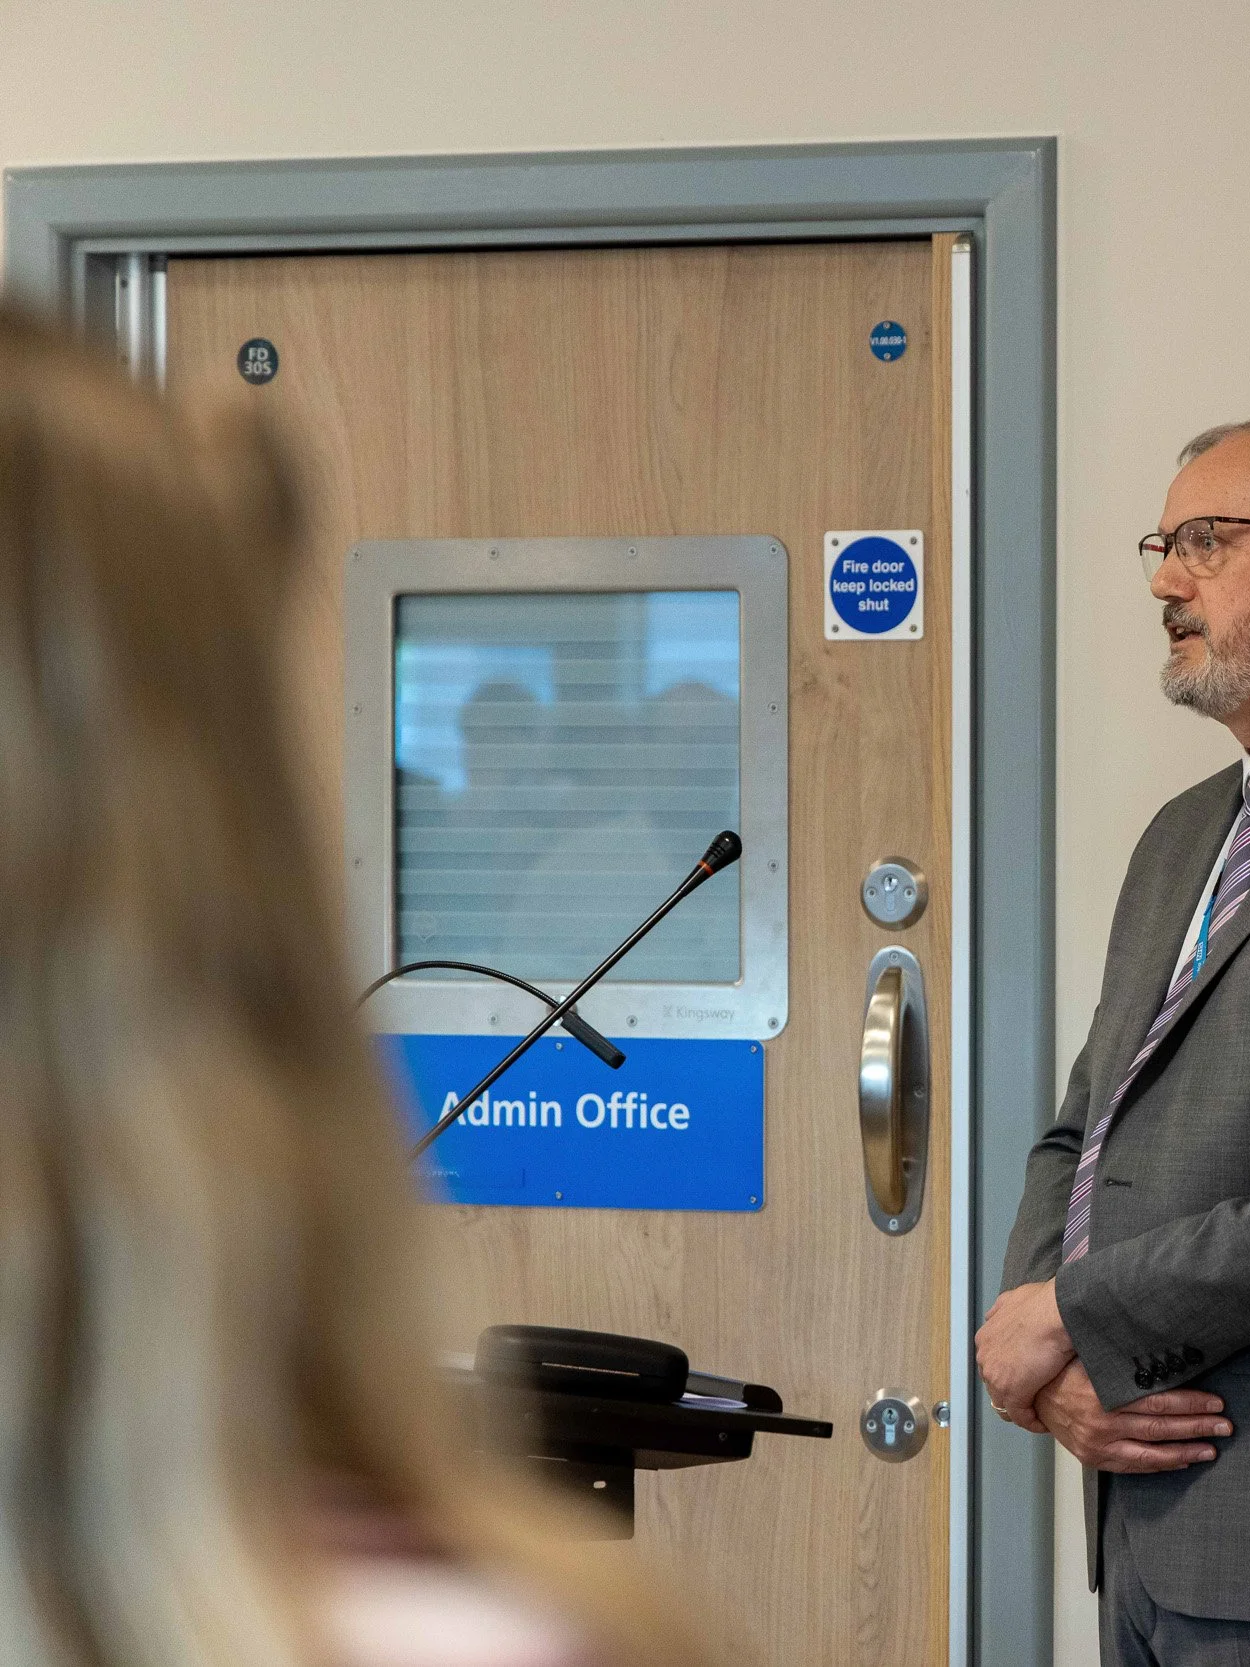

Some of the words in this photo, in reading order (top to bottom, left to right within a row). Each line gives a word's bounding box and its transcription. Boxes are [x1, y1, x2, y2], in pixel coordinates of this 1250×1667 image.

[248, 347, 269, 361] FD
[244, 361, 272, 375] 30S
[843, 560, 869, 573] Fire
[872, 559, 905, 573] door
[833, 579, 866, 595] keep
[869, 578, 914, 592] locked
[858, 598, 889, 611] shut
[676, 1005, 735, 1022] Kingsway
[437, 1090, 562, 1127] Admin
[575, 1091, 690, 1130] Office
